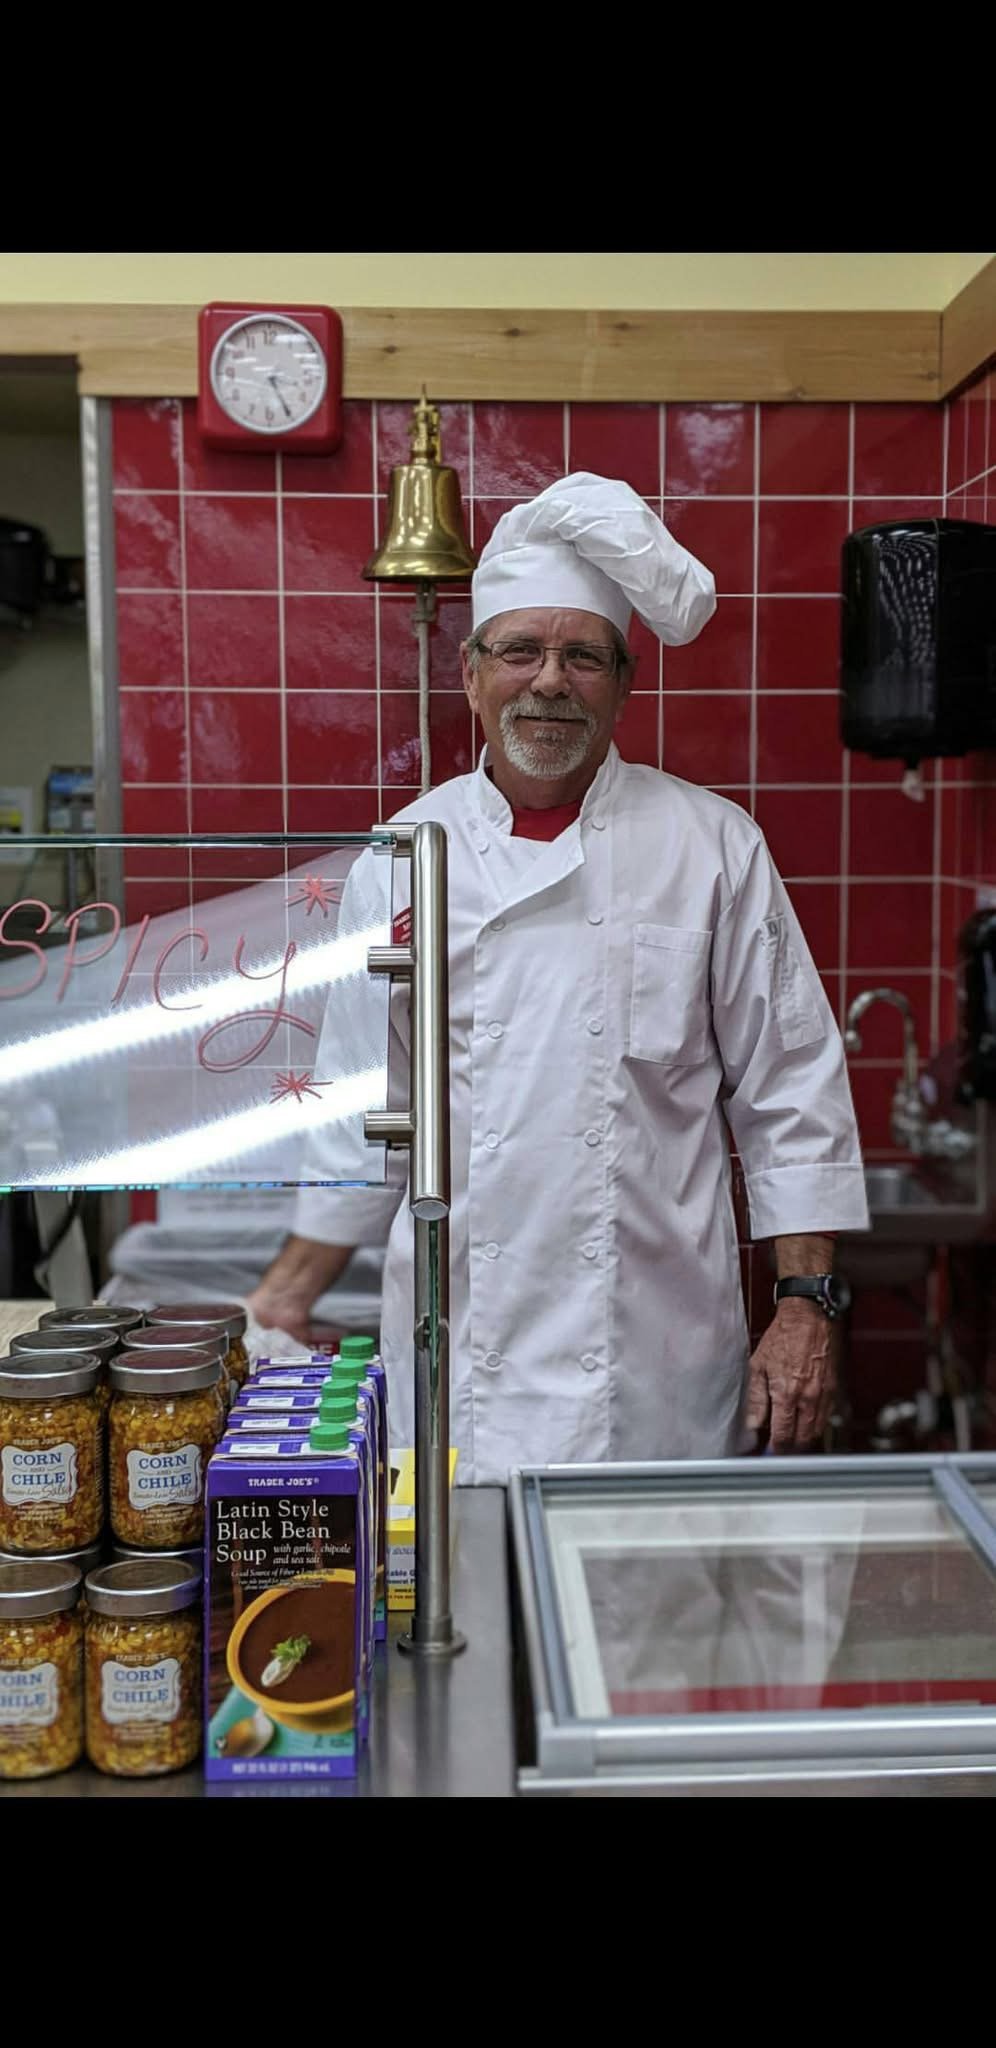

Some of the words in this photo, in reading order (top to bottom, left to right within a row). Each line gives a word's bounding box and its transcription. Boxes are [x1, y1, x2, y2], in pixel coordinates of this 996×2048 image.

[0, 900, 316, 1073] SPICY
[12, 1452, 62, 1466] CORN
[138, 1453, 188, 1470] CORN
[11, 1471, 66, 1486] CHILE
[137, 1472, 192, 1490] CHILE
[247, 1478, 285, 1487] TRADER
[216, 1500, 271, 1519] Latin
[278, 1499, 329, 1521] Style
[217, 1520, 272, 1541] Black
[281, 1520, 330, 1539] Bean
[216, 1543, 267, 1565] Soup
[273, 1543, 291, 1553] with
[320, 1543, 352, 1556] chipotle
[272, 1554, 289, 1564] and
[291, 1556, 304, 1564] sea
[0, 1671, 42, 1687] ORN
[113, 1667, 166, 1683] CORN
[0, 1691, 46, 1708] HILE
[112, 1688, 169, 1704] CHILE
